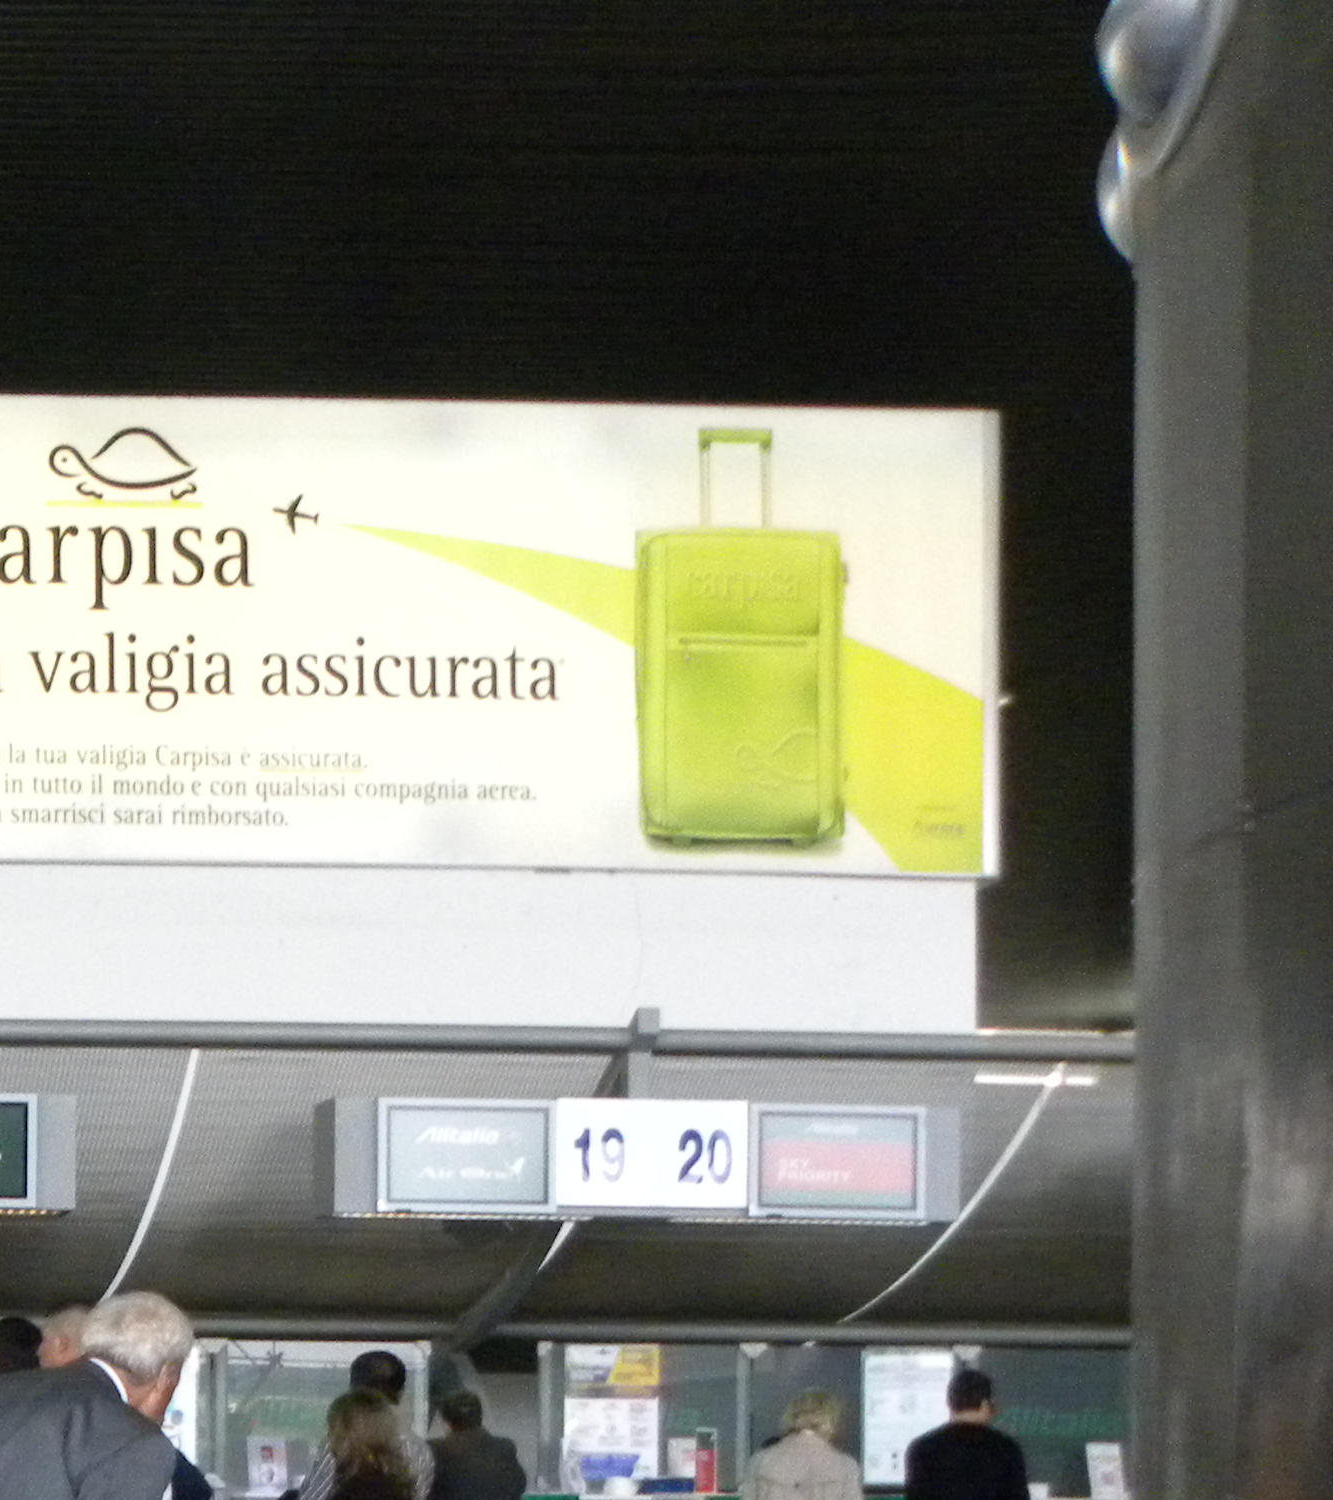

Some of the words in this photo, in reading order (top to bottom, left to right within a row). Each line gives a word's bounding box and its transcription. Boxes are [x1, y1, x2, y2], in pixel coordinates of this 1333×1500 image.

[28, 631, 234, 712] valigia
[261, 636, 559, 701] assicurata
[9, 743, 26, 764] la
[36, 747, 67, 765] tua
[77, 744, 146, 770] valigia
[155, 745, 232, 771] Carpisa
[259, 748, 368, 769] assicurata.
[4, 773, 23, 794] in
[33, 776, 82, 795] tutto
[91, 774, 103, 795] il
[113, 775, 185, 796] mondo
[192, 781, 202, 796] e
[210, 781, 247, 797] con
[256, 777, 346, 803] qualsiasi
[354, 778, 468, 805] compagnia
[477, 783, 537, 801] aerea.
[10, 803, 105, 825] smarrisci
[113, 804, 163, 826] sarai
[172, 804, 289, 827] rimborsato.
[414, 1126, 501, 1145] Alitalia
[573, 1126, 626, 1184] 19
[677, 1128, 733, 1187] 20
